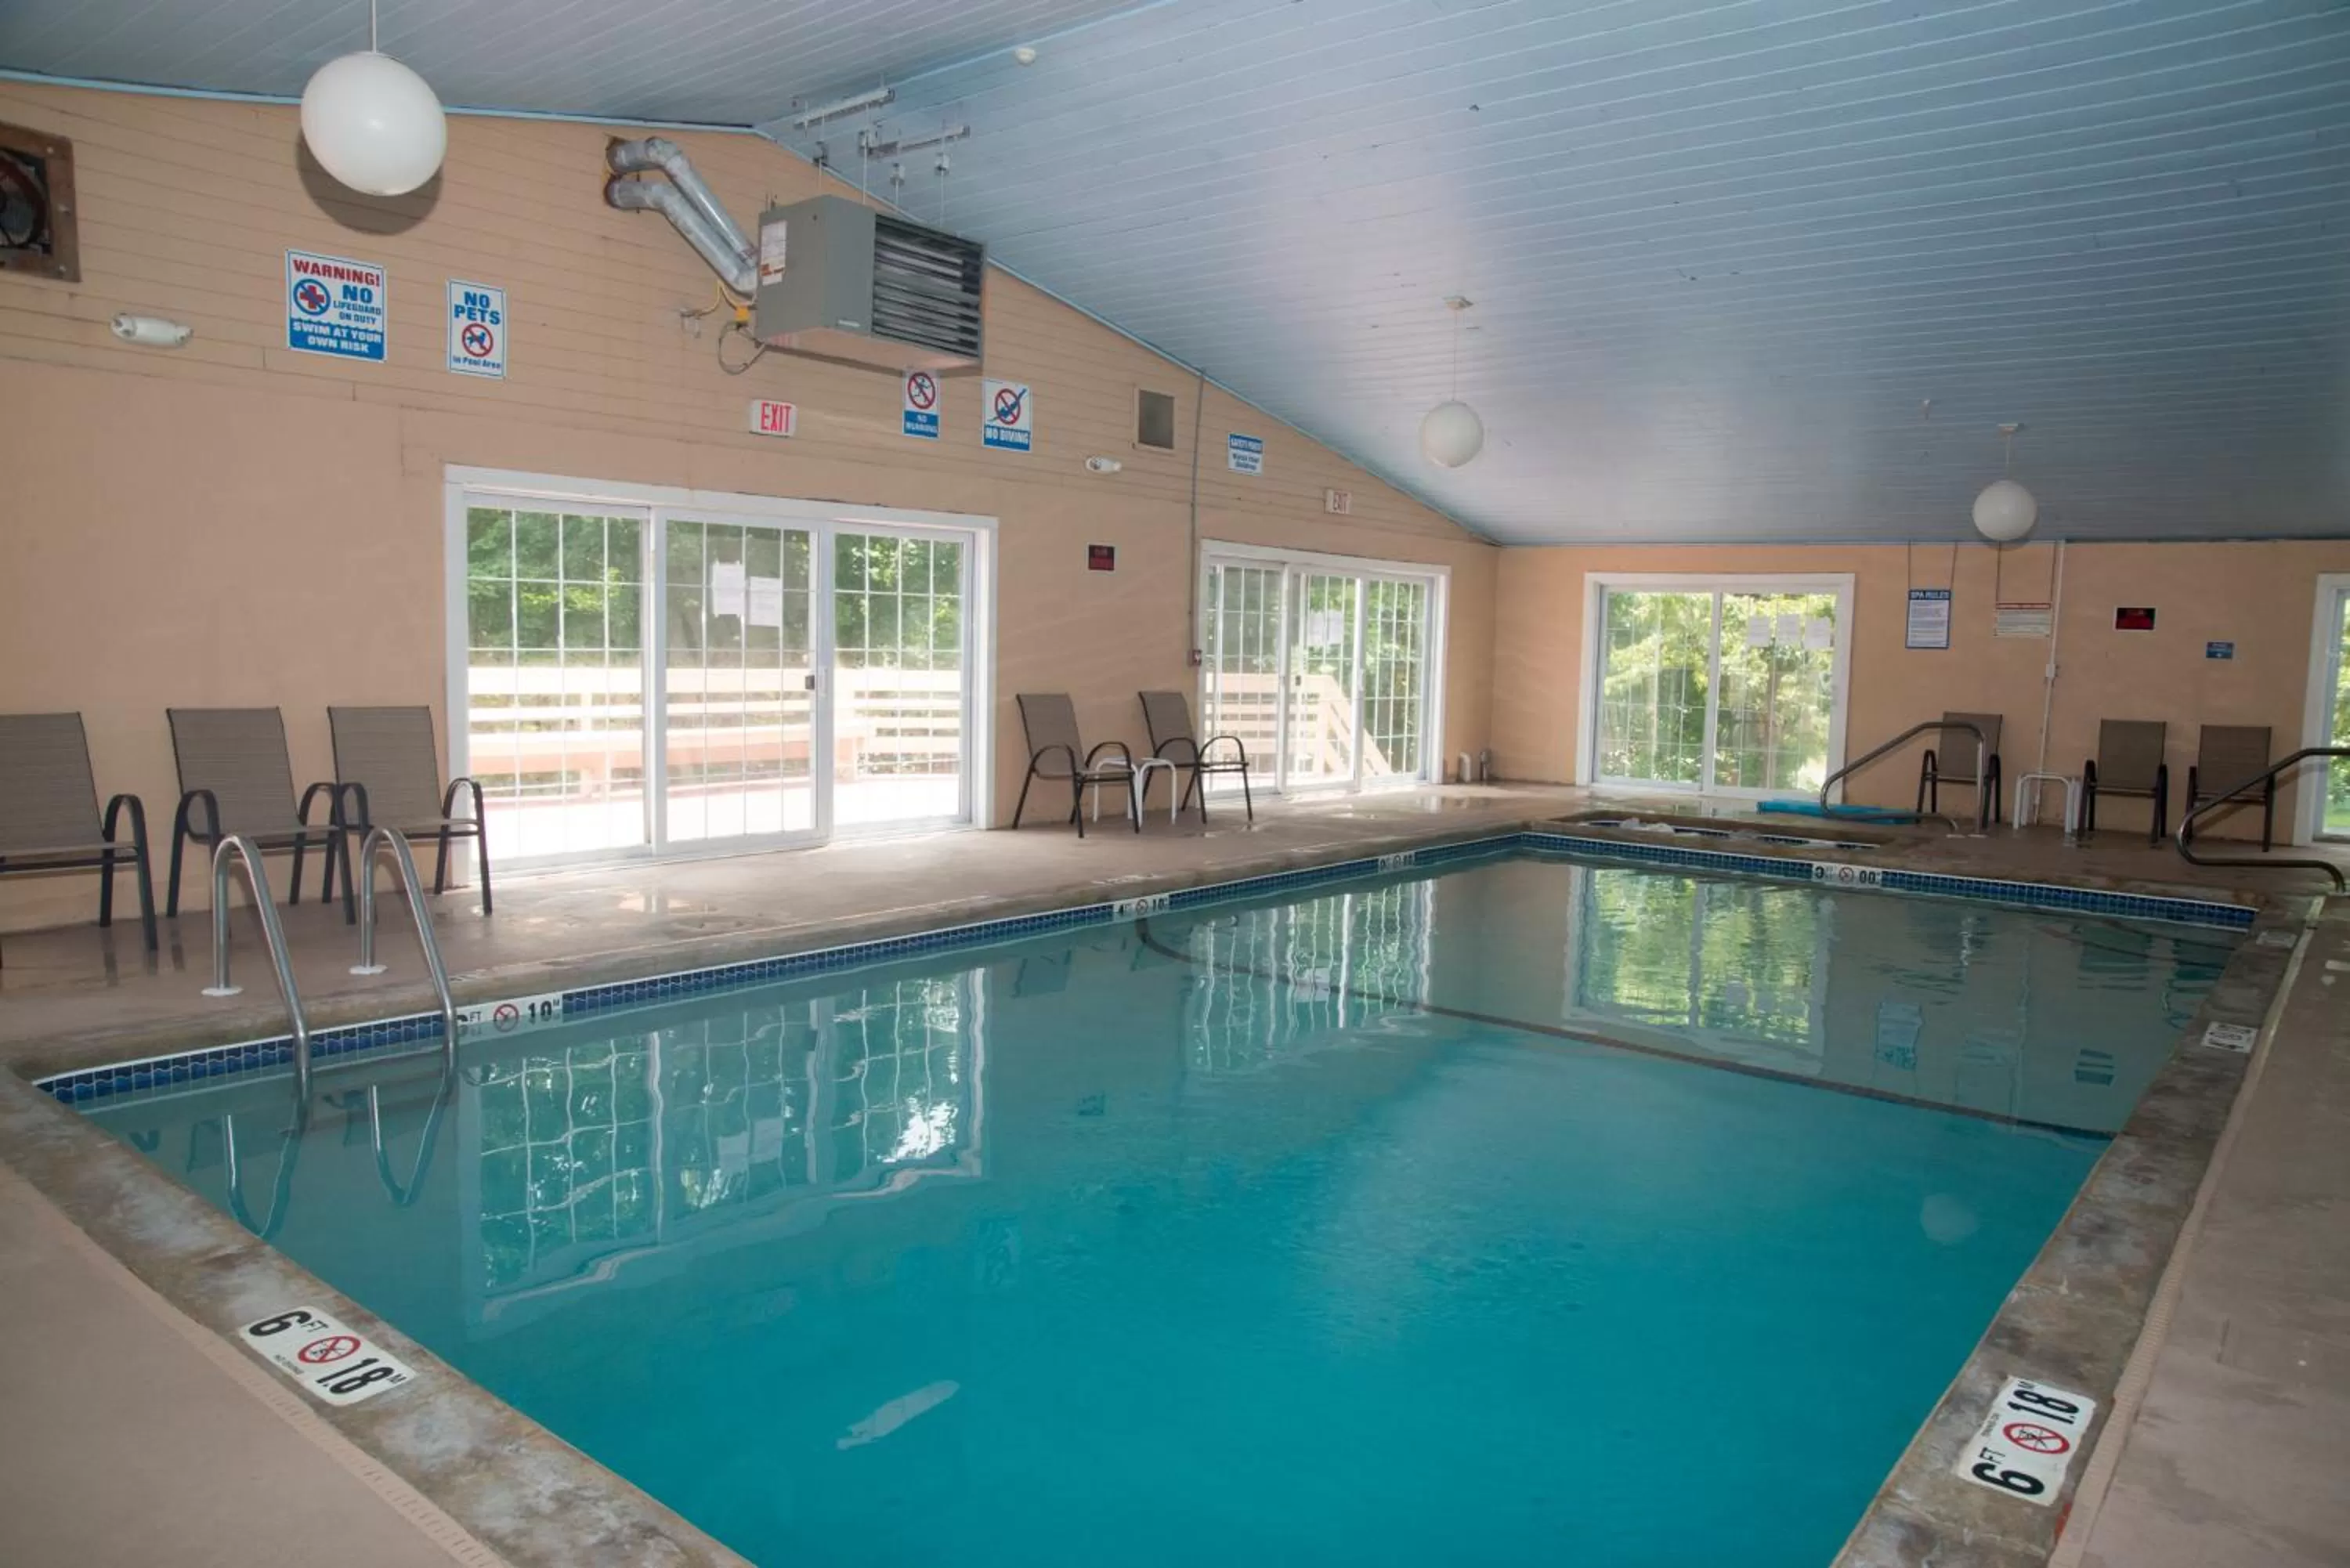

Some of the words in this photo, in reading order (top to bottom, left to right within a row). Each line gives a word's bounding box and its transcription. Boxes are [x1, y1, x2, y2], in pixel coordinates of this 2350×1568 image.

[293, 259, 380, 287] WARNING!
[342, 284, 373, 304] NO
[464, 291, 490, 309] NO
[334, 300, 381, 315] LIFEGUARD
[454, 303, 501, 325] PETS
[339, 312, 352, 320] ON
[353, 314, 376, 325] DUTY
[293, 321, 330, 334] SWIM
[333, 327, 349, 338] AT
[350, 329, 381, 342] YOUR
[308, 334, 338, 349] OWN
[341, 339, 370, 353] RISK
[761, 401, 792, 433] EXIT
[985, 428, 999, 440] NO
[1000, 430, 1029, 445] DIVING
[1910, 591, 1925, 599] SPA
[1926, 591, 1950, 599] RULES
[249, 1310, 312, 1336] 6
[1972, 1462, 2045, 1495] 6
